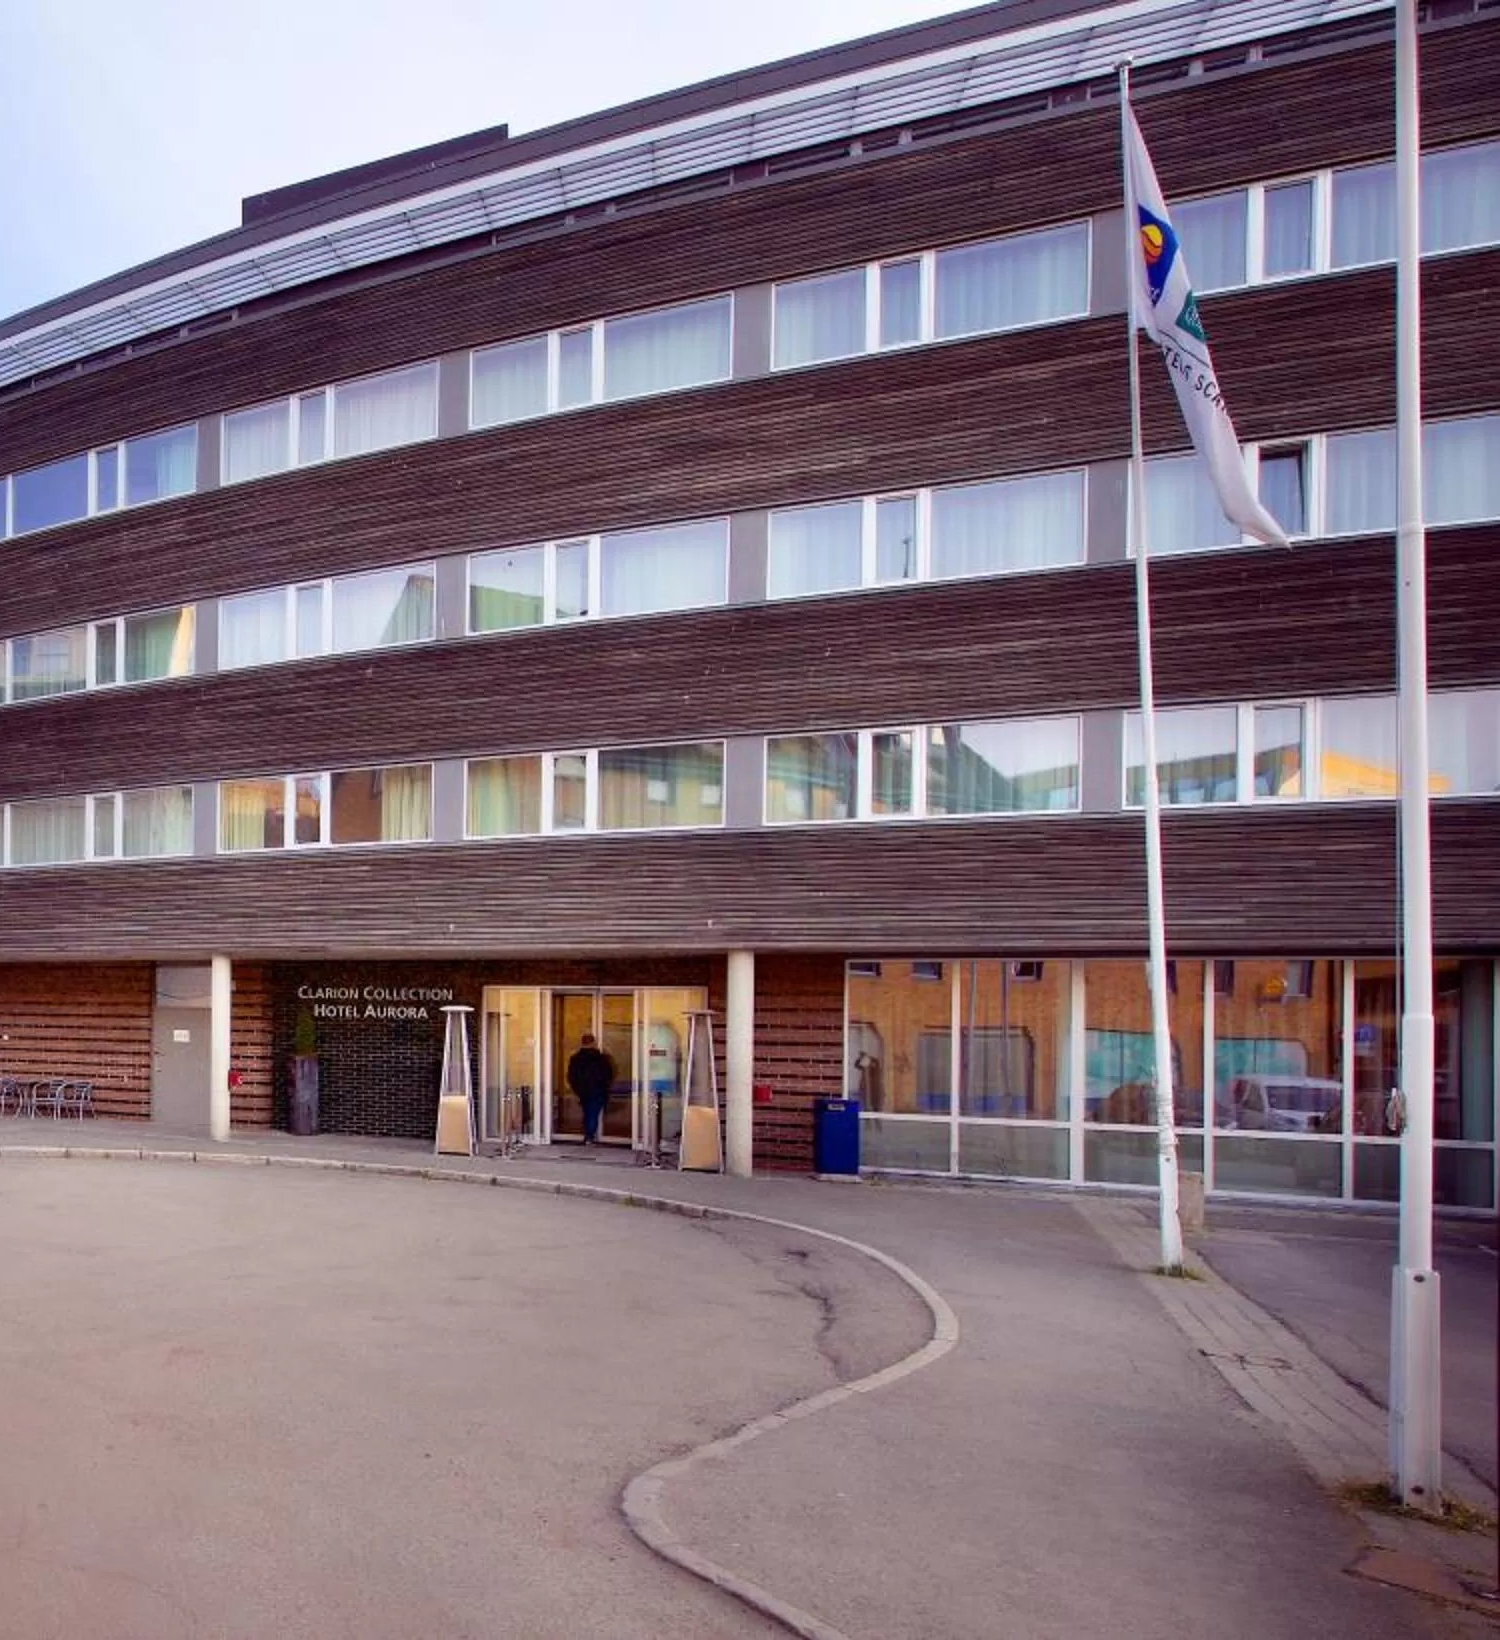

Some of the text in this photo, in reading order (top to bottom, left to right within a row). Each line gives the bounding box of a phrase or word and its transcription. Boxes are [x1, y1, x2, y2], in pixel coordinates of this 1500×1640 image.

[297, 985, 454, 1001] CLARION COLLECTION
[313, 1003, 430, 1020] HOTEL AURORA
